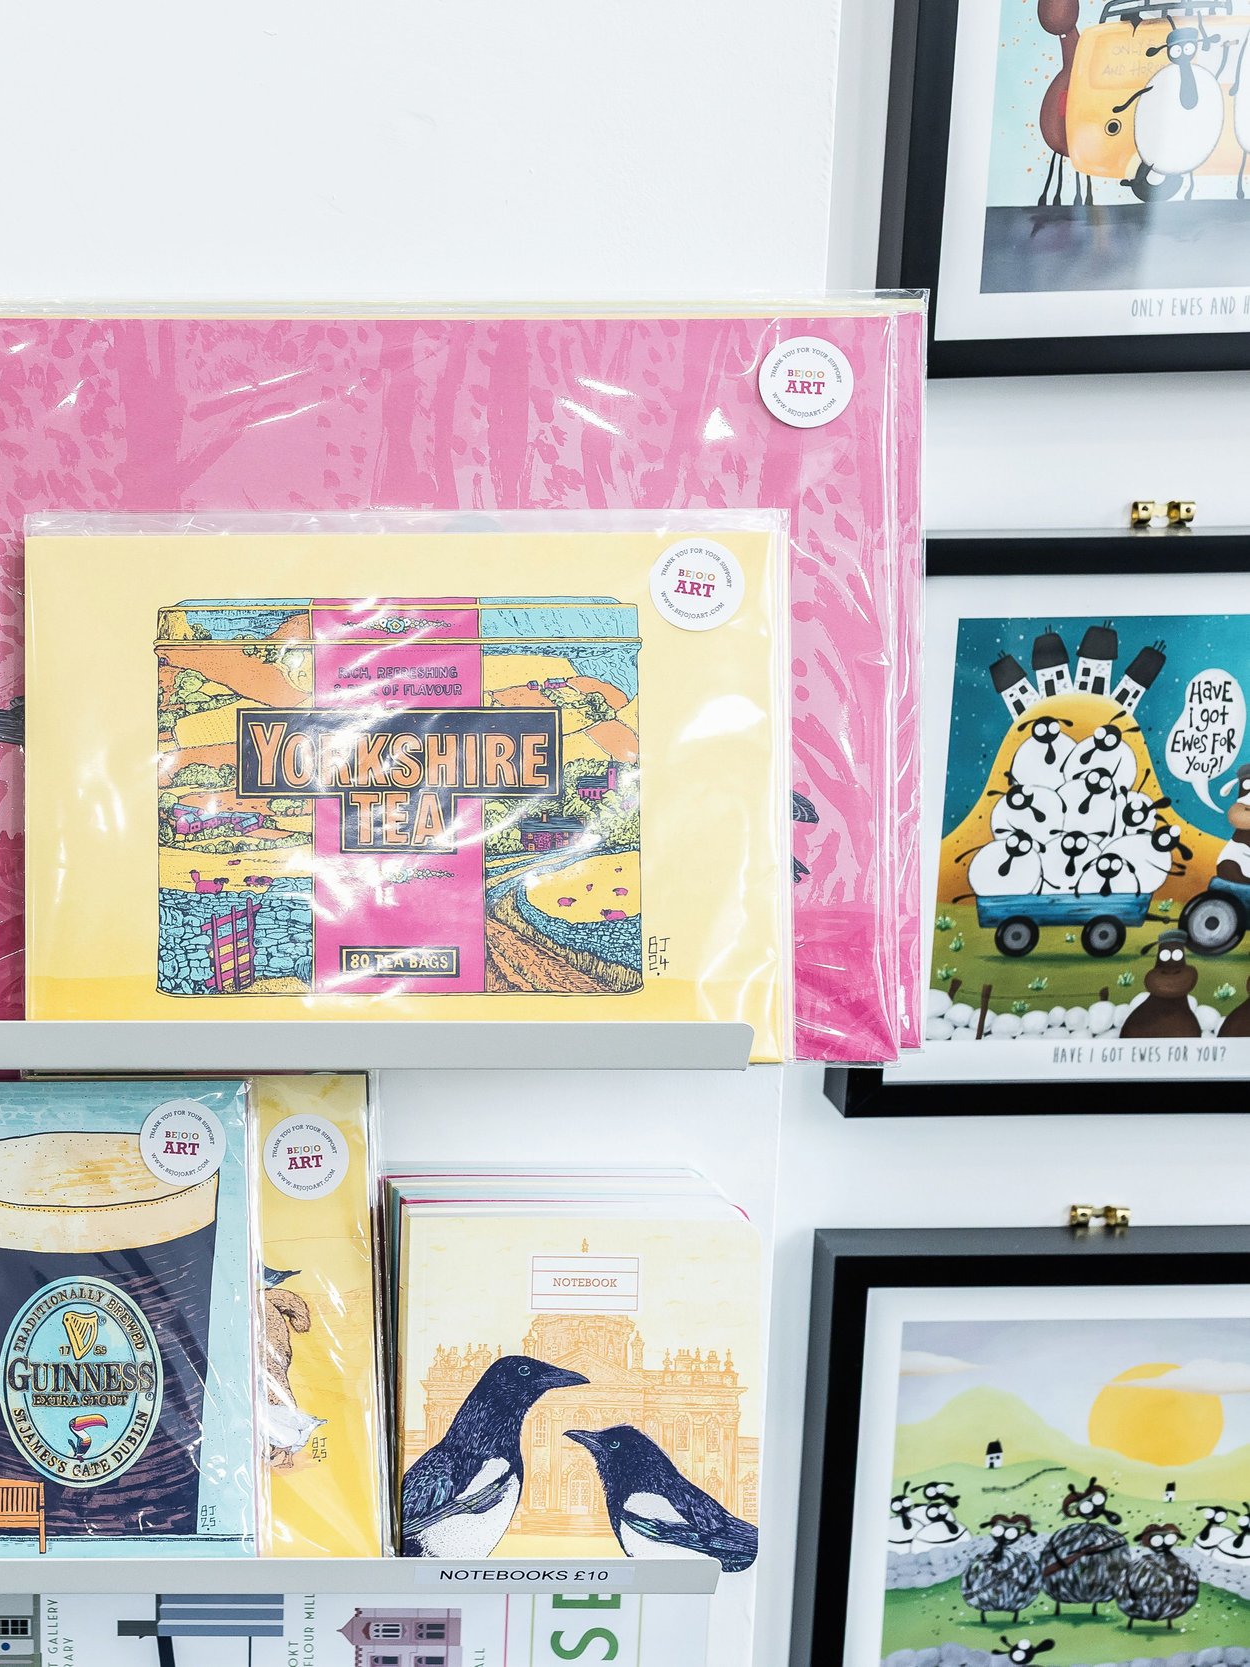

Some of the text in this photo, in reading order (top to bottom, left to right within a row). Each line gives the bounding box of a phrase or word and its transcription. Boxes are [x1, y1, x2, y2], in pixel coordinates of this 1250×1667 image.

[1131, 298, 1164, 317] ONLY
[1171, 297, 1203, 316] EWES
[1210, 296, 1236, 315] AND
[770, 358, 784, 378] THANK
[782, 349, 796, 359] YOU
[812, 348, 829, 360] YOUR
[827, 358, 842, 383] SUPPORT
[787, 369, 825, 380] BEJOJO
[785, 380, 825, 395] ART
[661, 557, 676, 577] THANK
[675, 549, 689, 558] YOU
[704, 549, 721, 562] YOUR
[719, 561, 732, 588] SUPPORT
[678, 568, 716, 582] BEJOJO
[674, 579, 715, 598] ART
[377, 666, 458, 679] REFRESHING
[382, 684, 399, 696] OF
[403, 683, 462, 696] FLAVOUR
[1195, 705, 1229, 732] got
[247, 721, 549, 788] YORKSHIRE
[349, 792, 451, 846] TEA
[350, 953, 449, 969] 80 TEA BAGS
[1053, 1046, 1227, 1063] HAVE I GOT EWES FOR YOU?
[149, 1120, 162, 1139] THANK
[160, 1112, 173, 1121] YOU
[187, 1111, 203, 1122] YOUR
[201, 1120, 215, 1145] SUPPORT
[165, 1131, 199, 1141] BEJOJO
[163, 1141, 200, 1156] ART
[272, 1124, 338, 1158] THANK YOU FOR YOUR SUPPORT
[287, 1145, 321, 1155] BEJOJO
[151, 1152, 210, 1177] WWW.BEJOJOART.COM
[287, 1155, 323, 1170] ART
[277, 1168, 336, 1192] WWW.BEJOJOART.COM
[552, 1277, 618, 1288] NOTEBOOK
[14, 1287, 146, 1352] TRADITIONALLY BREWED
[7, 1356, 155, 1393] GUINNESS
[32, 1394, 128, 1407] EXTRA STOUT
[19, 1426, 67, 1473] JAMES'S
[111, 1410, 148, 1463] DUBLIN
[440, 1570, 608, 1581] NOTEBOOKS £10
[47, 1599, 58, 1654] GALLERY
[303, 1594, 315, 1667] FLOUR MILL
